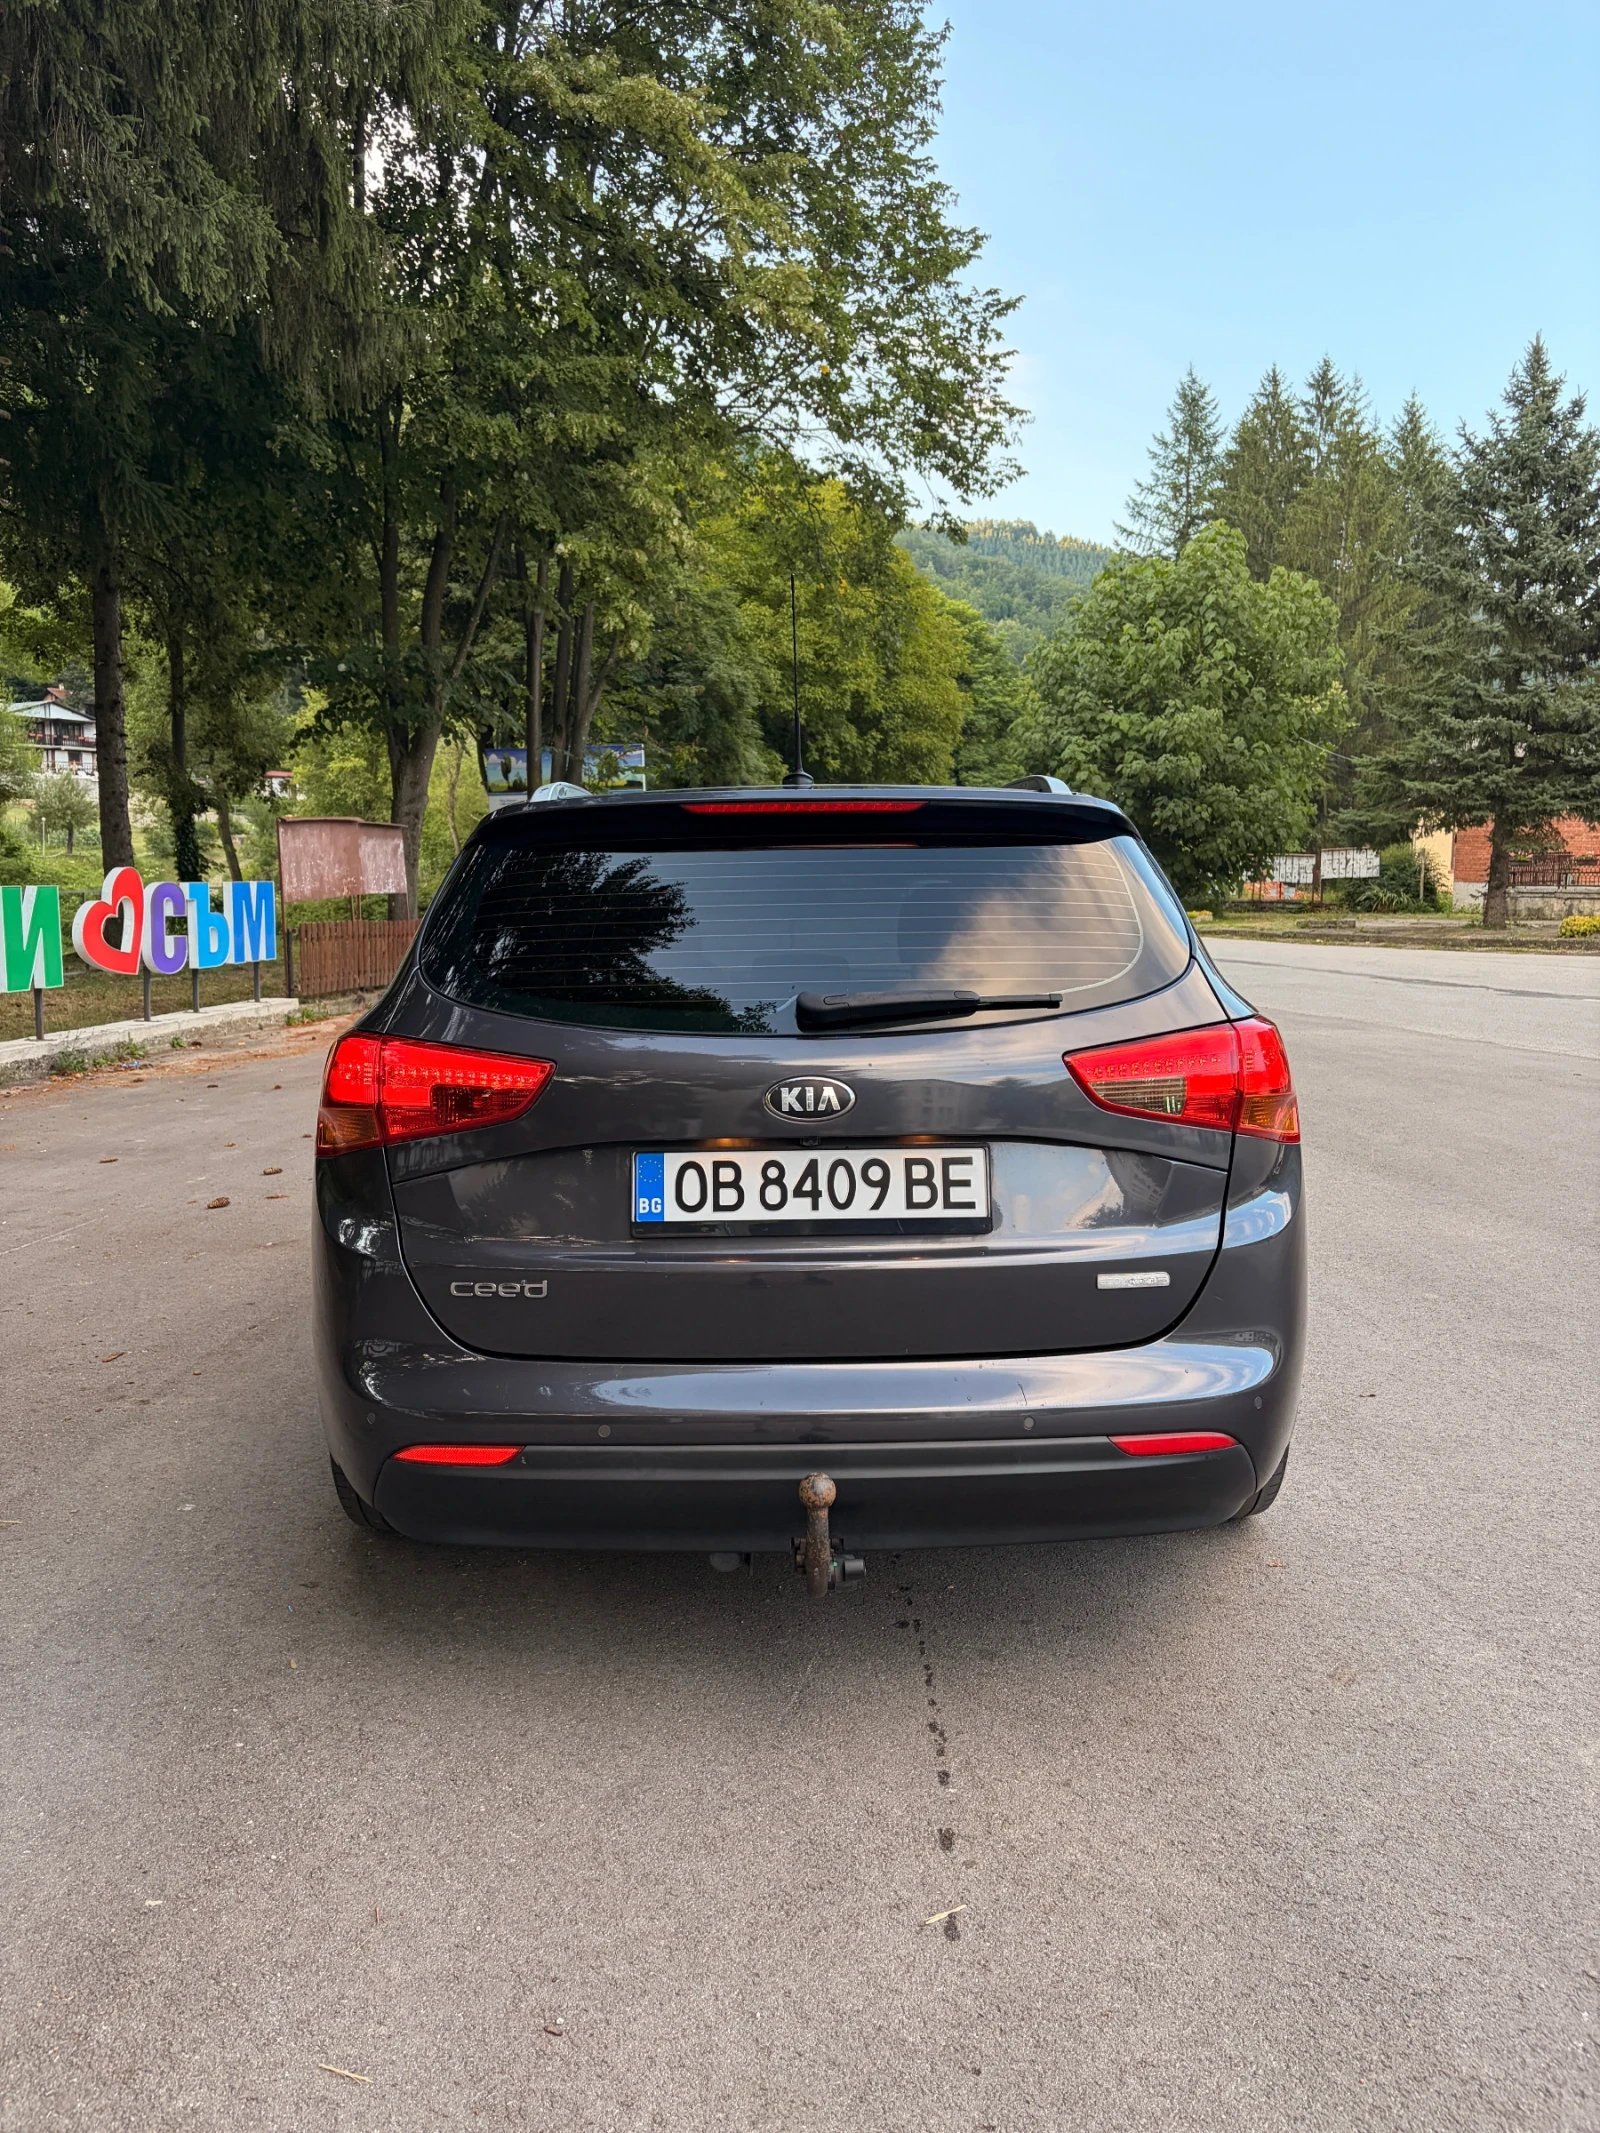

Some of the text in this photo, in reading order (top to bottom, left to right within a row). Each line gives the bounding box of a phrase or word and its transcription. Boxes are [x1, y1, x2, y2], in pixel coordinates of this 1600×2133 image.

[145, 880, 277, 975] СЪМ
[780, 1086, 841, 1112] KIA
[674, 1156, 976, 1213] OB 8409 BE
[638, 1197, 663, 1214] BG
